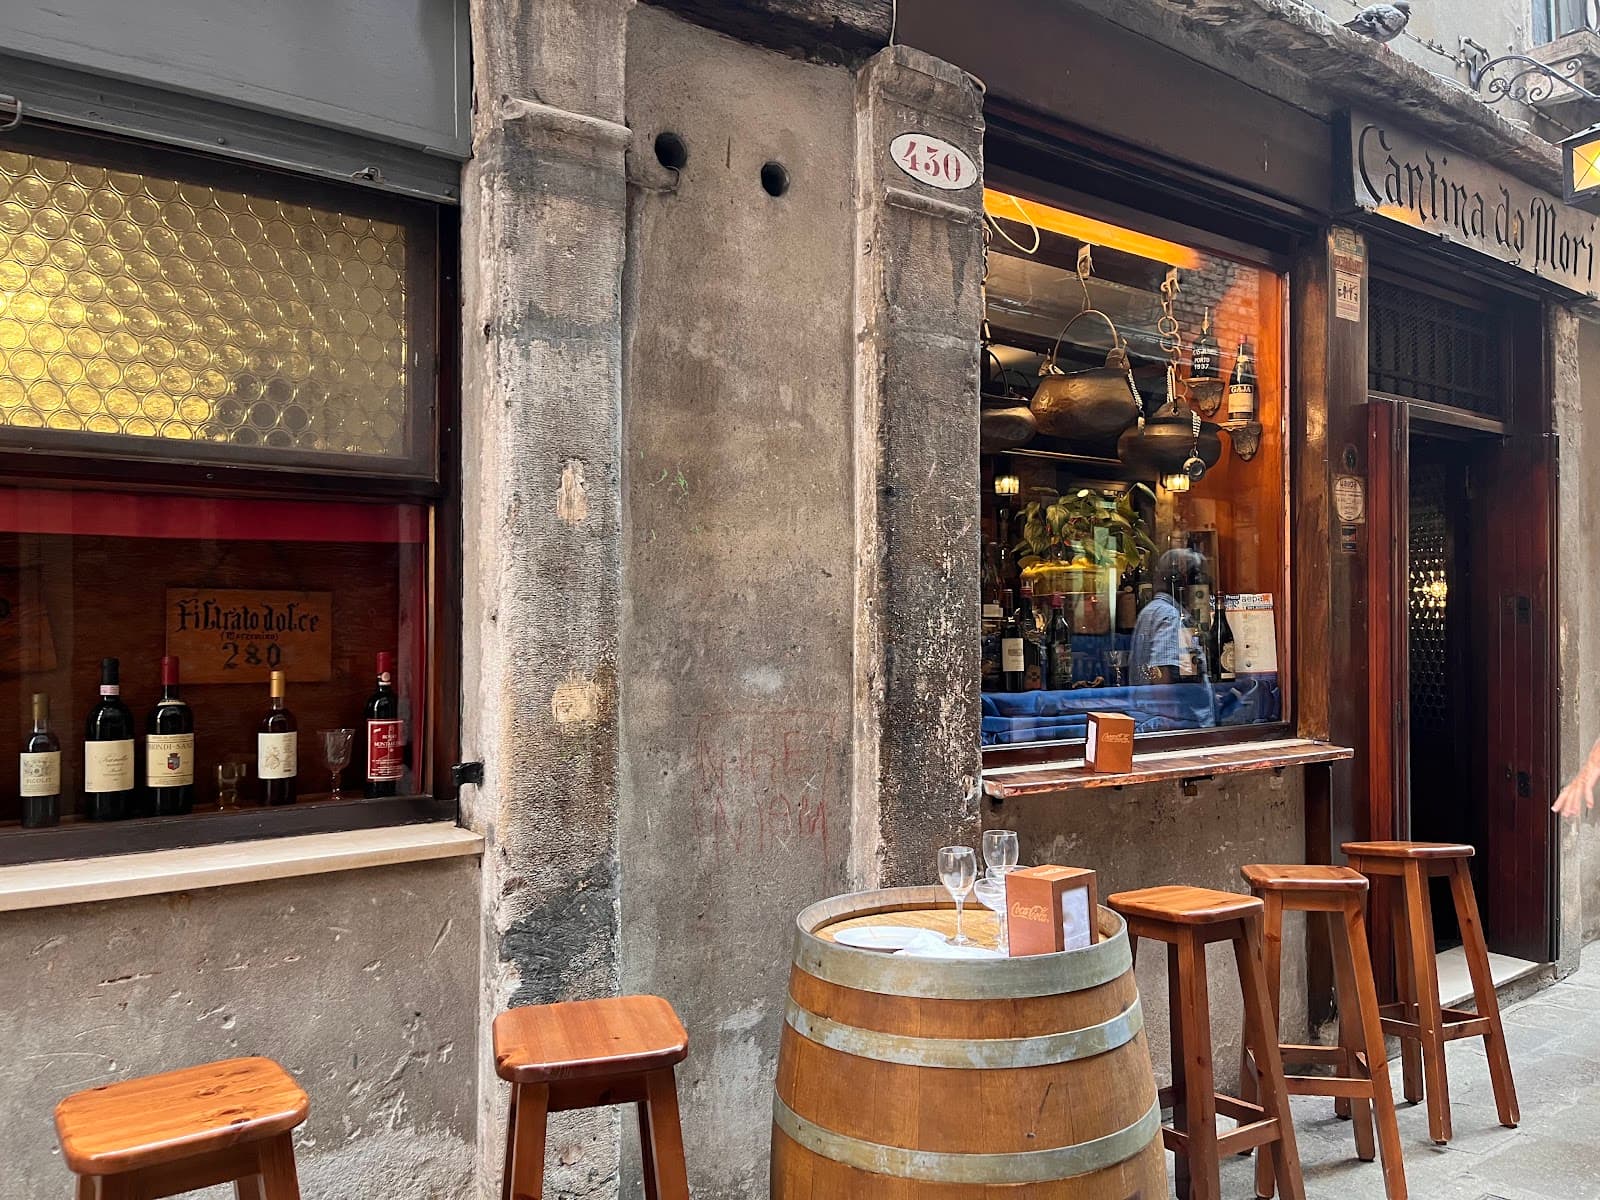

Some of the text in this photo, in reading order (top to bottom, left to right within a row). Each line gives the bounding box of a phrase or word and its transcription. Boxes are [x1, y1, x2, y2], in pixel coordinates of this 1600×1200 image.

[901, 141, 961, 182] 430
[1357, 122, 1486, 241] Cantina
[1529, 195, 1595, 283] Mori
[175, 597, 320, 633] Filtrato dolce
[222, 642, 282, 670] 280
[1011, 901, 1050, 924] Coca-Cola
